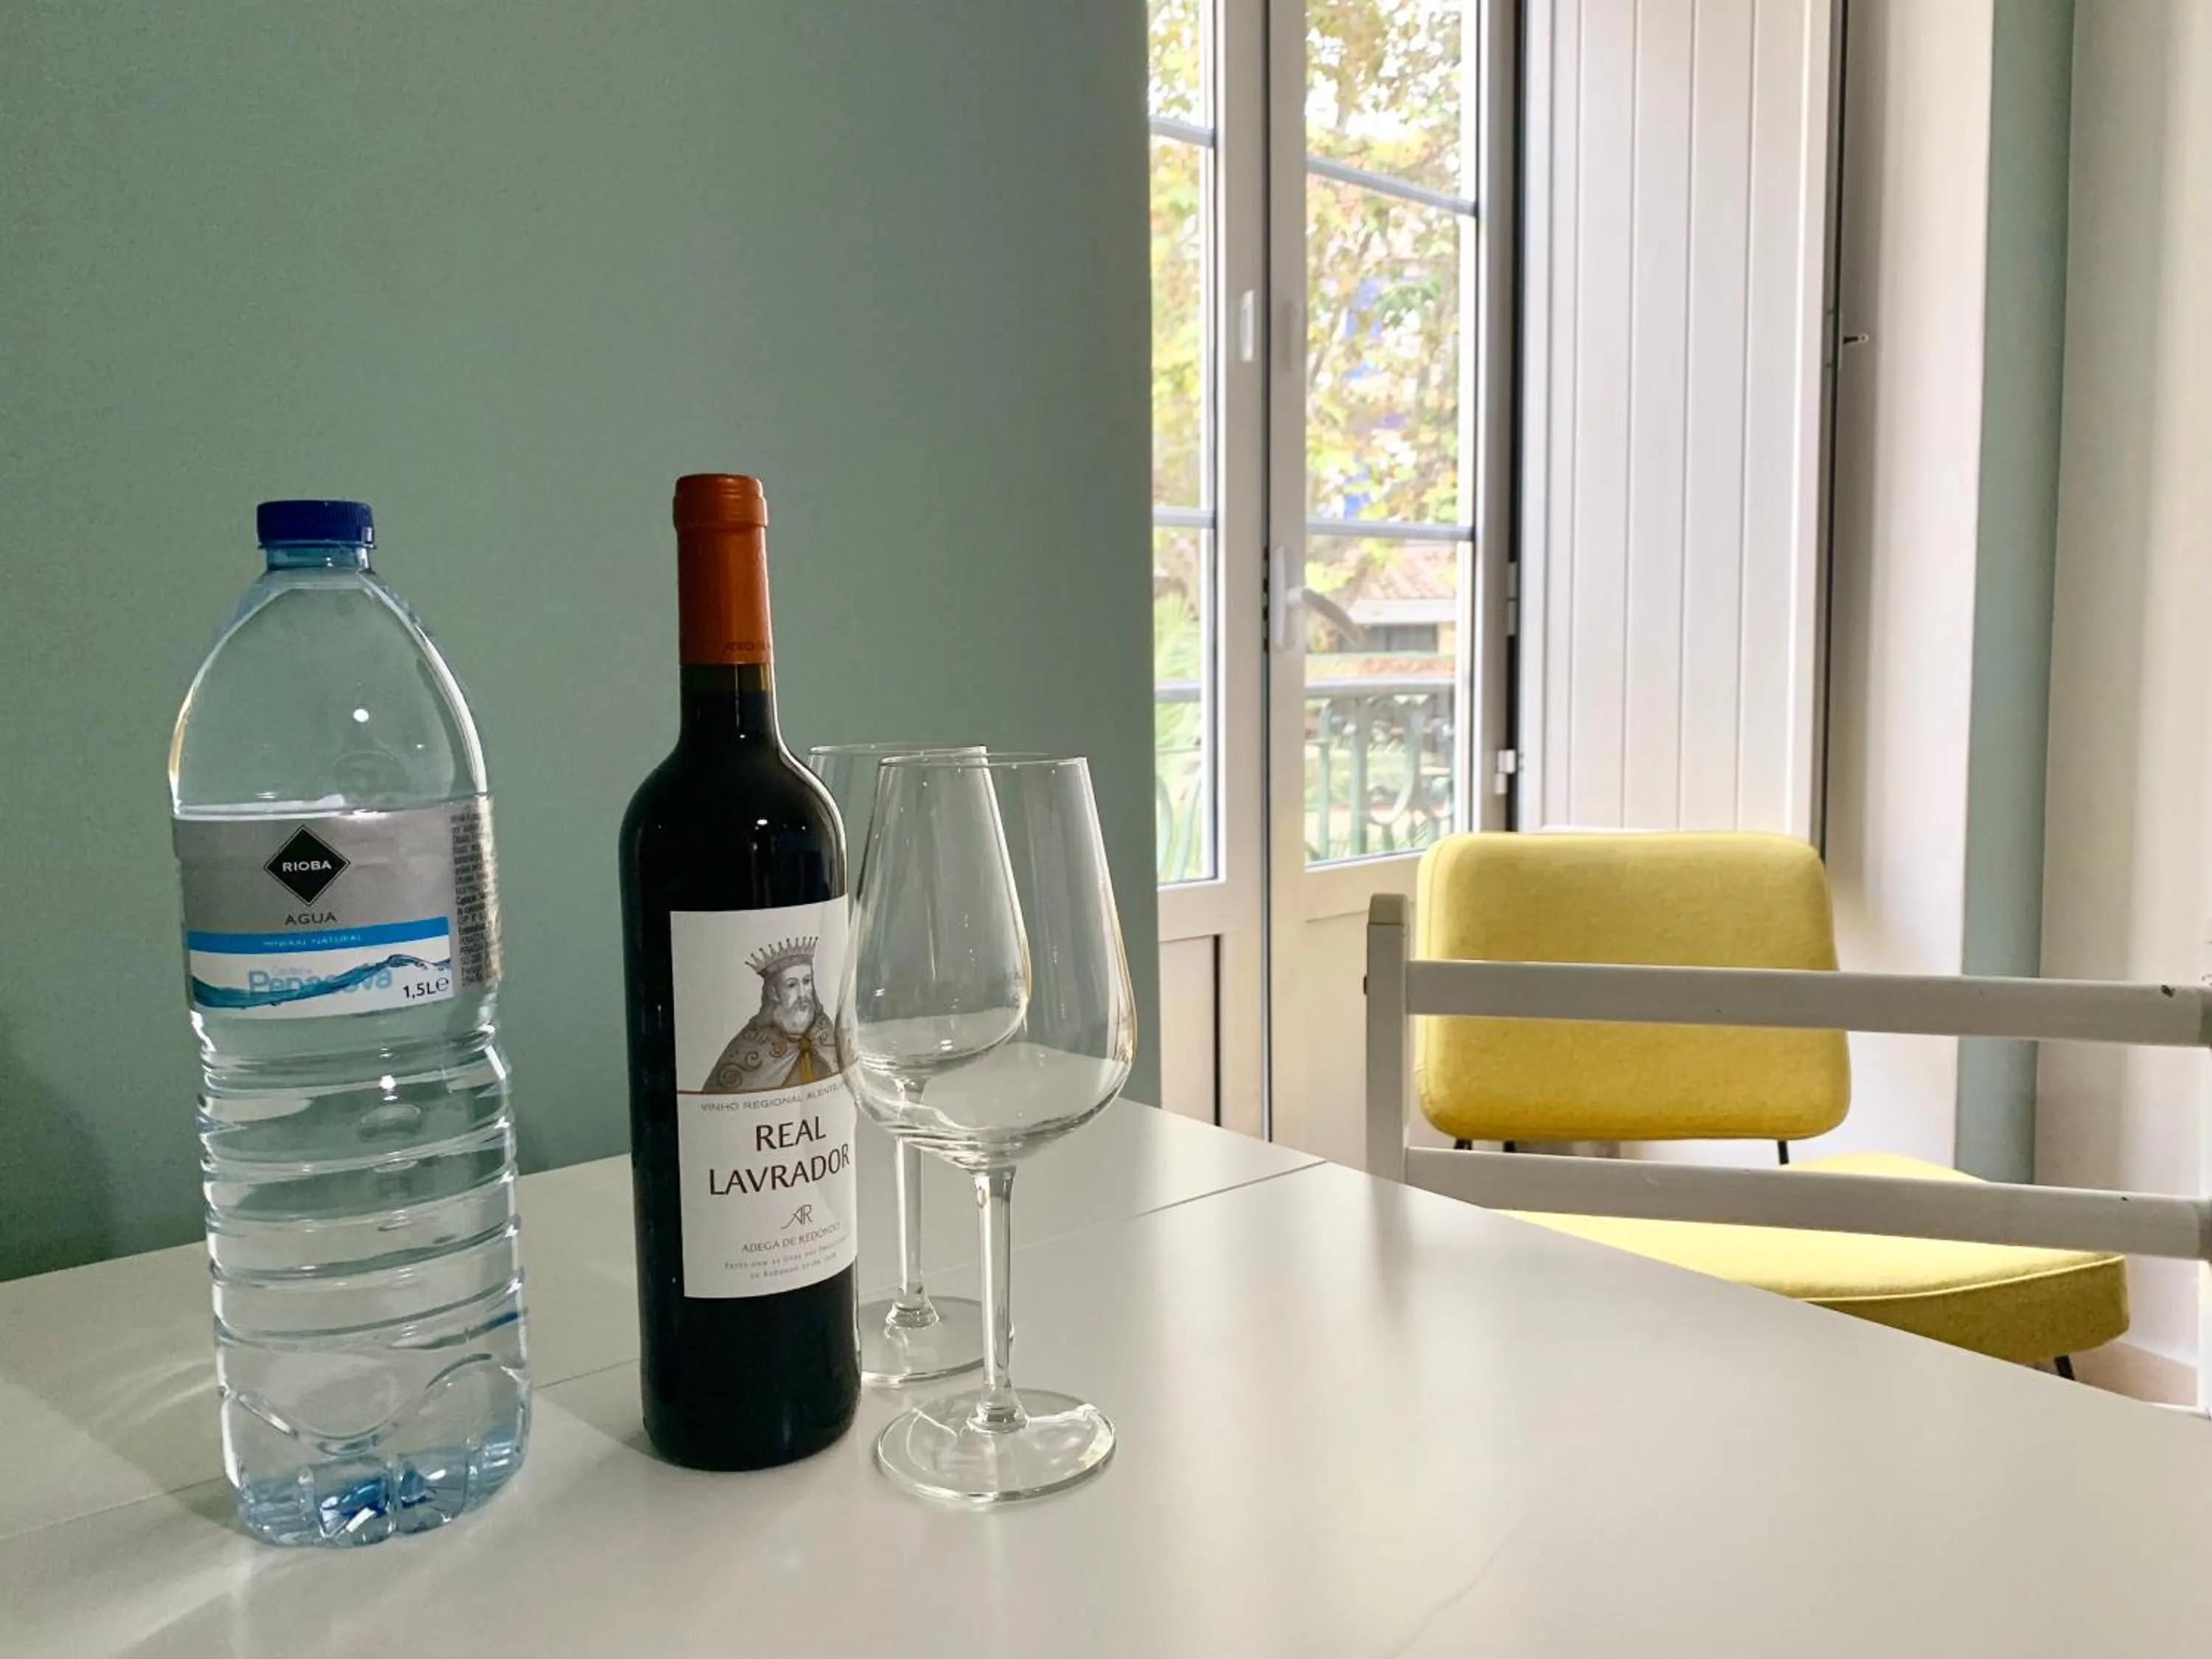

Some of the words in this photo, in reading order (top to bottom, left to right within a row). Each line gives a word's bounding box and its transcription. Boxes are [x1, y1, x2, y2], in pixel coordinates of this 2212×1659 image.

[282, 860, 332, 872] RIOBA
[285, 911, 337, 926] AGUA
[701, 1102, 740, 1112] VINHO
[742, 1095, 802, 1110] REGIONAL
[756, 1116, 827, 1152] REAL
[709, 1144, 850, 1195] LAVRADOR
[741, 1241, 779, 1253] ADEGA
[782, 1238, 796, 1248] DE
